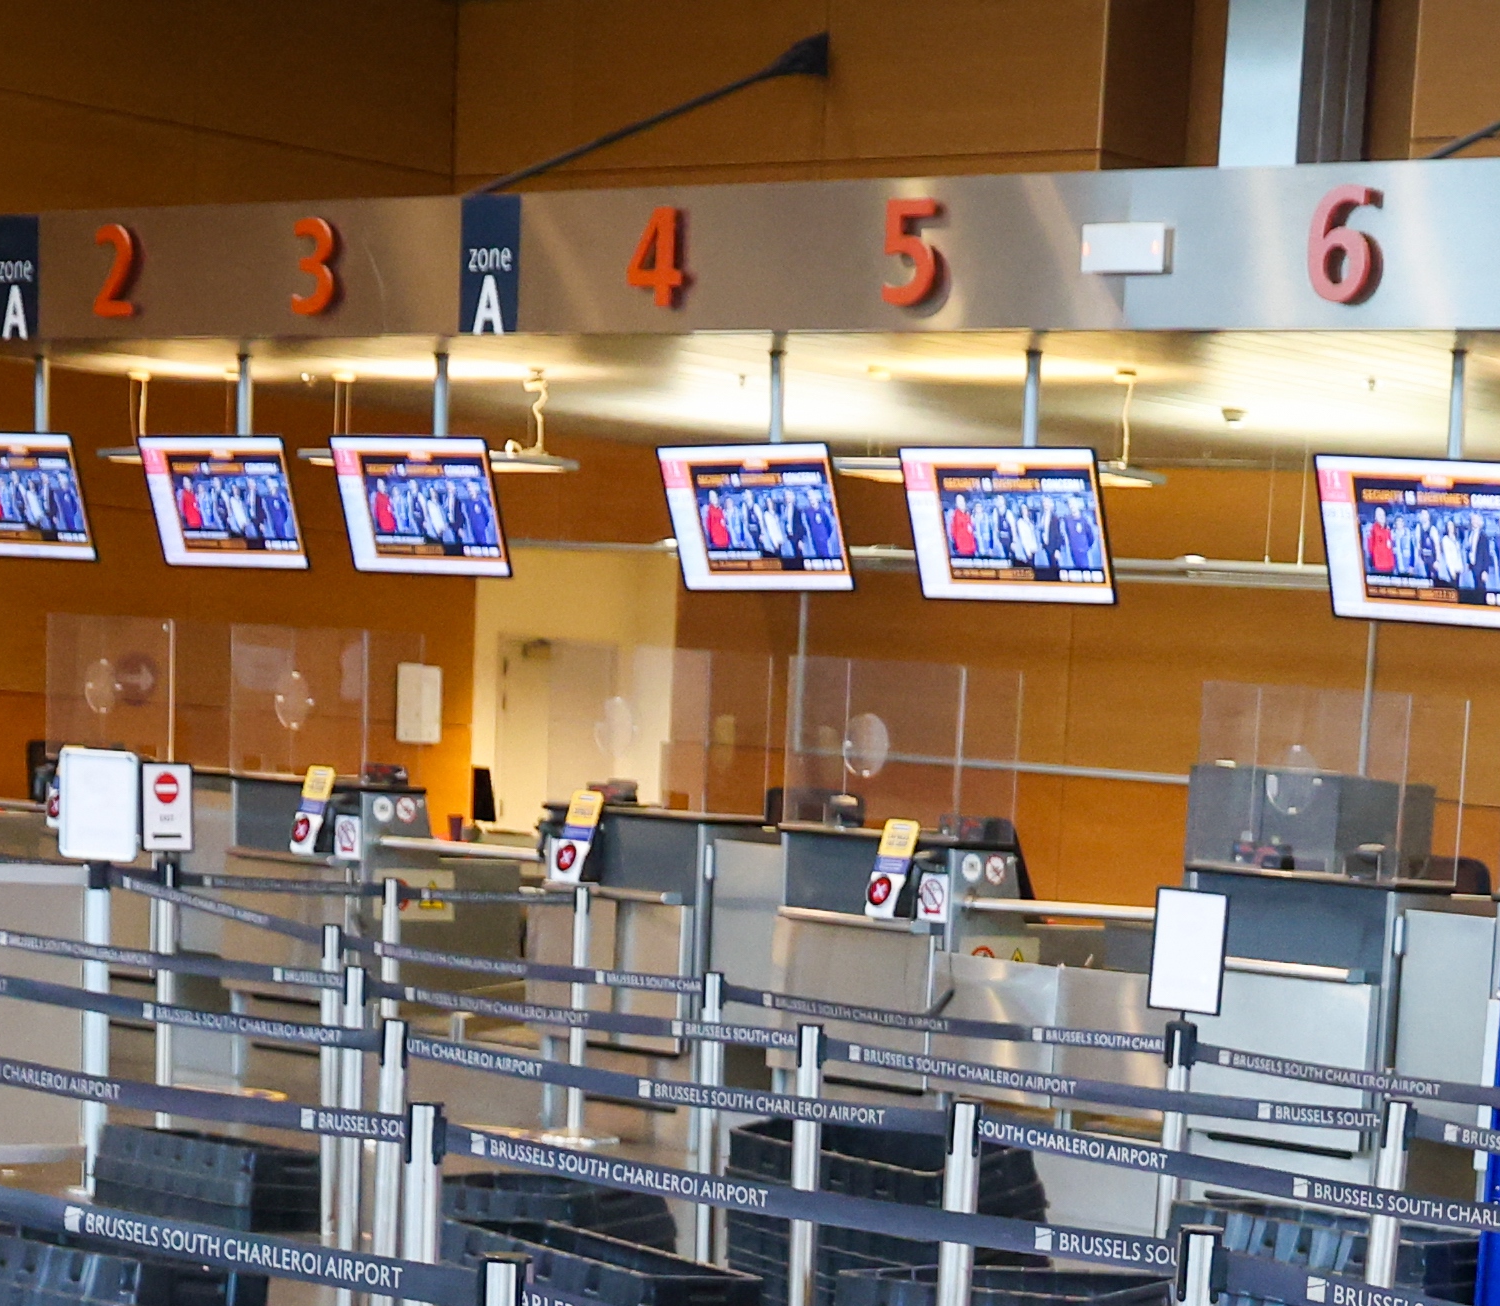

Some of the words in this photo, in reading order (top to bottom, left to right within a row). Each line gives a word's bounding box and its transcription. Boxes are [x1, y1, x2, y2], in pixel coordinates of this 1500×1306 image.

[93, 223, 138, 317] 2
[291, 217, 336, 316] 3
[468, 246, 512, 274] zone
[627, 206, 683, 306] 4
[881, 198, 938, 305] 5
[1308, 184, 1383, 303] 6
[3, 286, 28, 340] A
[473, 275, 503, 334] A
[1315, 1182, 1384, 1213] BRUSSELS
[1387, 1190, 1444, 1222] SOUTH
[85, 1213, 159, 1249] BRUSSELS
[162, 1228, 219, 1260] SOUTH
[224, 1237, 321, 1277] CHARLEROI
[324, 1256, 403, 1289] AIRPORT
[1059, 1233, 1139, 1262] BRUSSELS
